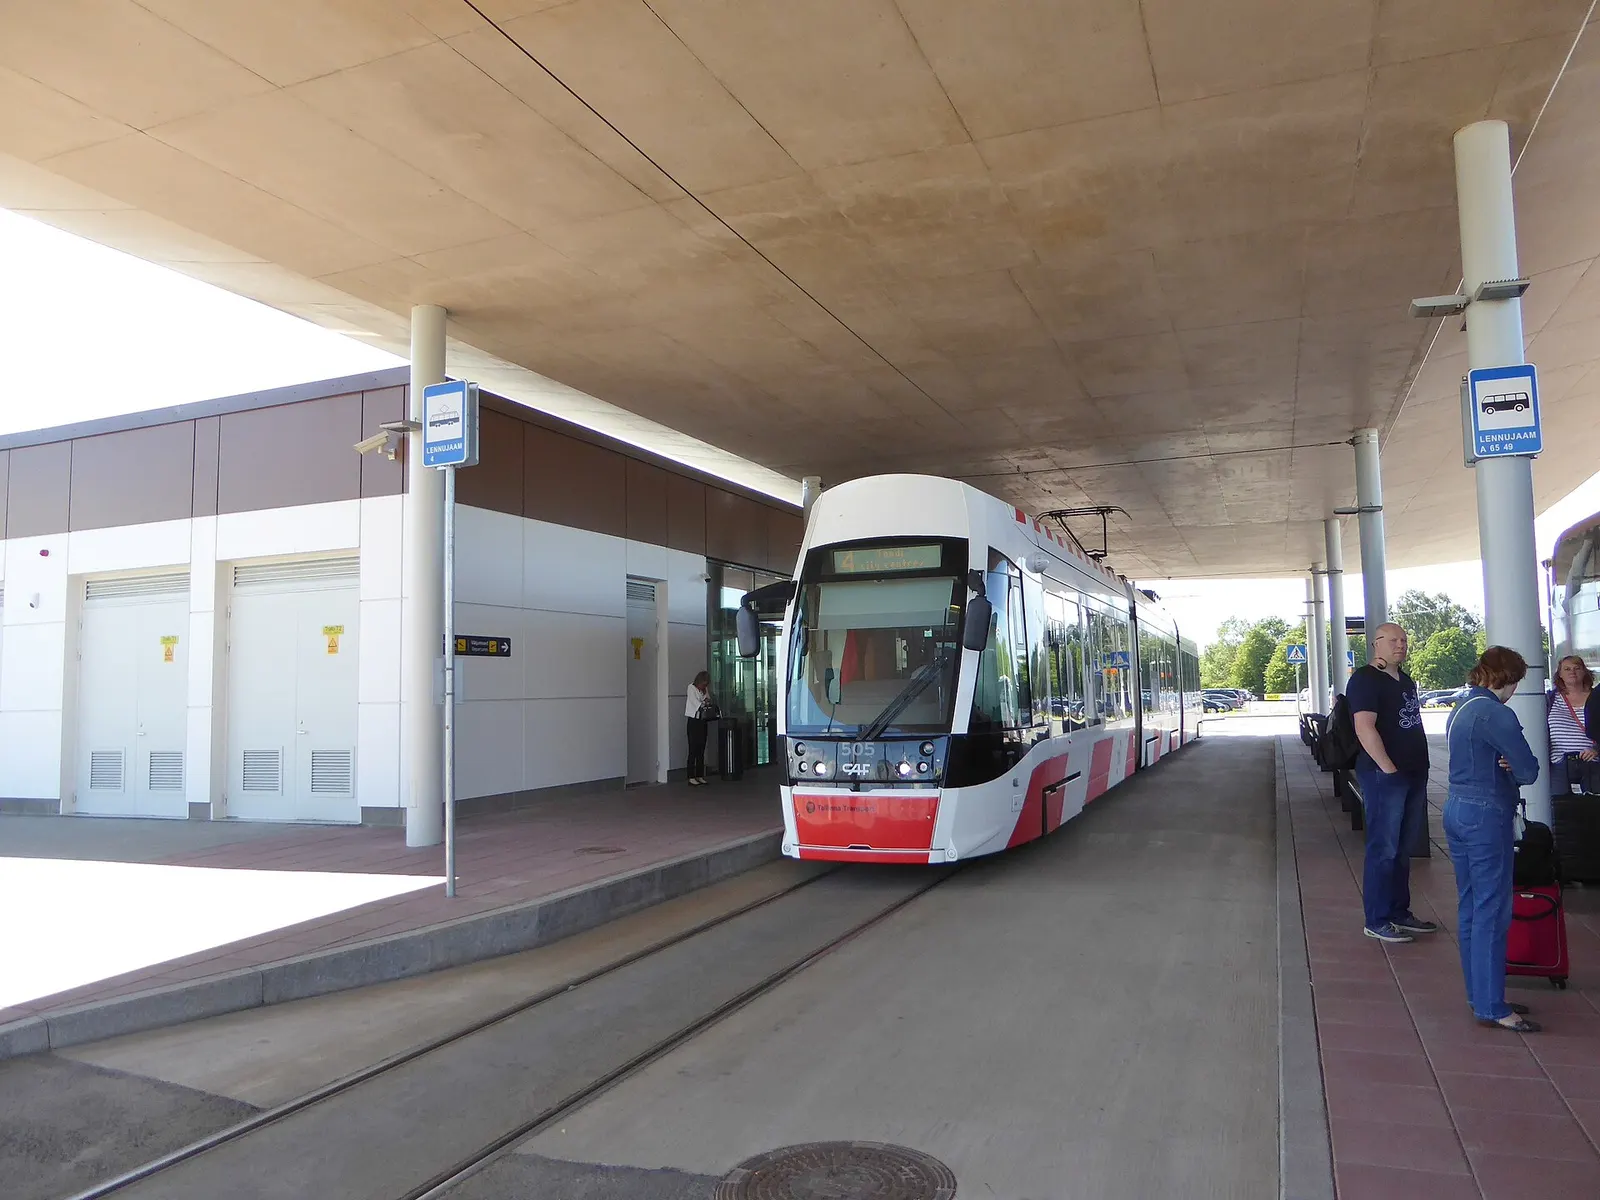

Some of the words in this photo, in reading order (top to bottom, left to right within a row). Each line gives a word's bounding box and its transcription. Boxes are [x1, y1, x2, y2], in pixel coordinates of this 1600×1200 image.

[1480, 432, 1536, 442] LENNUJAAM
[426, 443, 462, 454] LENNUJAAM
[1480, 445, 1487, 453] A
[1490, 444, 1500, 452] 65
[841, 551, 854, 570] 4
[841, 742, 875, 756] 505
[842, 763, 870, 775] CAF
